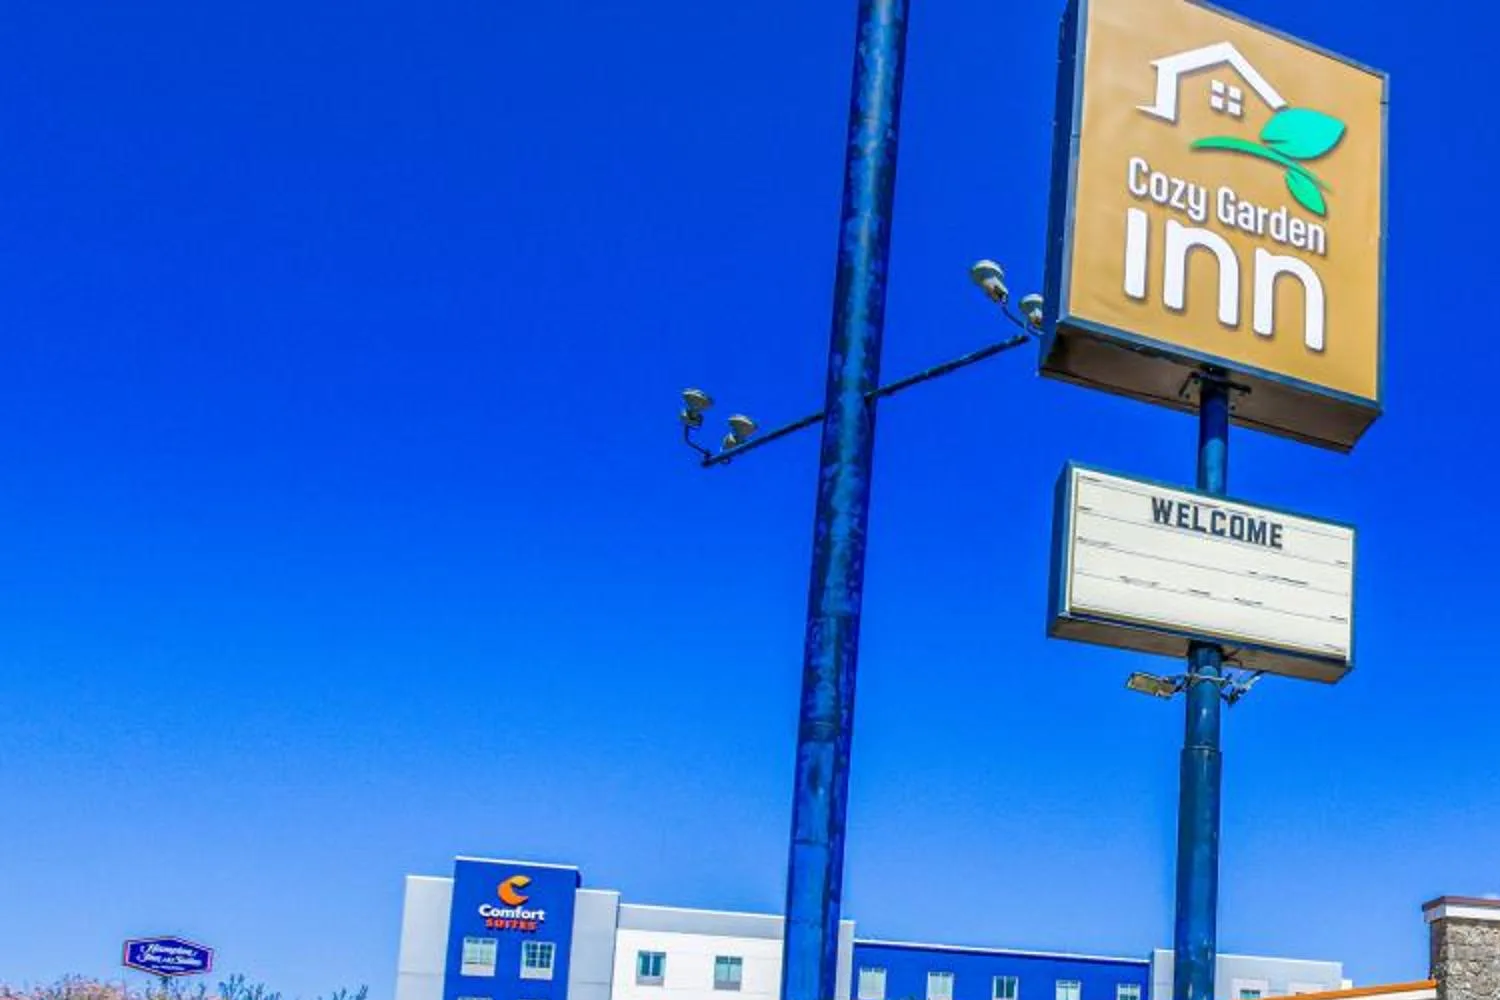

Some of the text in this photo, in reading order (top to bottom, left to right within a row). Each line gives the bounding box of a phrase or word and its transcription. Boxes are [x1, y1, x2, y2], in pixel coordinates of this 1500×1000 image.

[1127, 156, 1326, 256] Cozy Garden
[1151, 496, 1284, 550] WELCOME
[478, 903, 546, 920] Comfort
